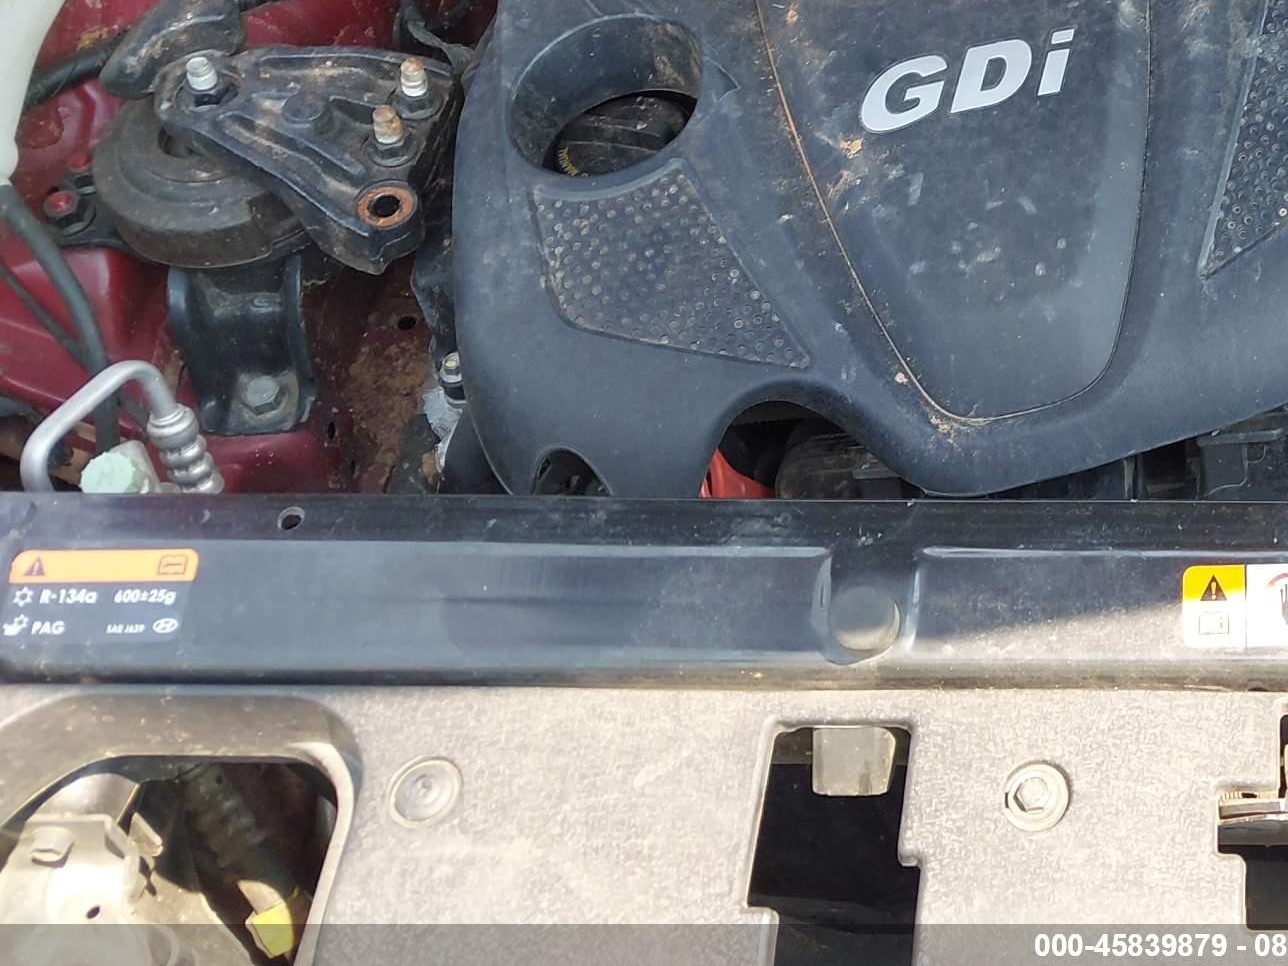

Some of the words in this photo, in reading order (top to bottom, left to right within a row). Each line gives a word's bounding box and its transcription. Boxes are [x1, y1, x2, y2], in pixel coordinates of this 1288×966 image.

[861, 29, 1075, 132] GDi
[39, 588, 97, 604] R-134a
[114, 588, 176, 605] 600±25g
[31, 620, 64, 634] PAG
